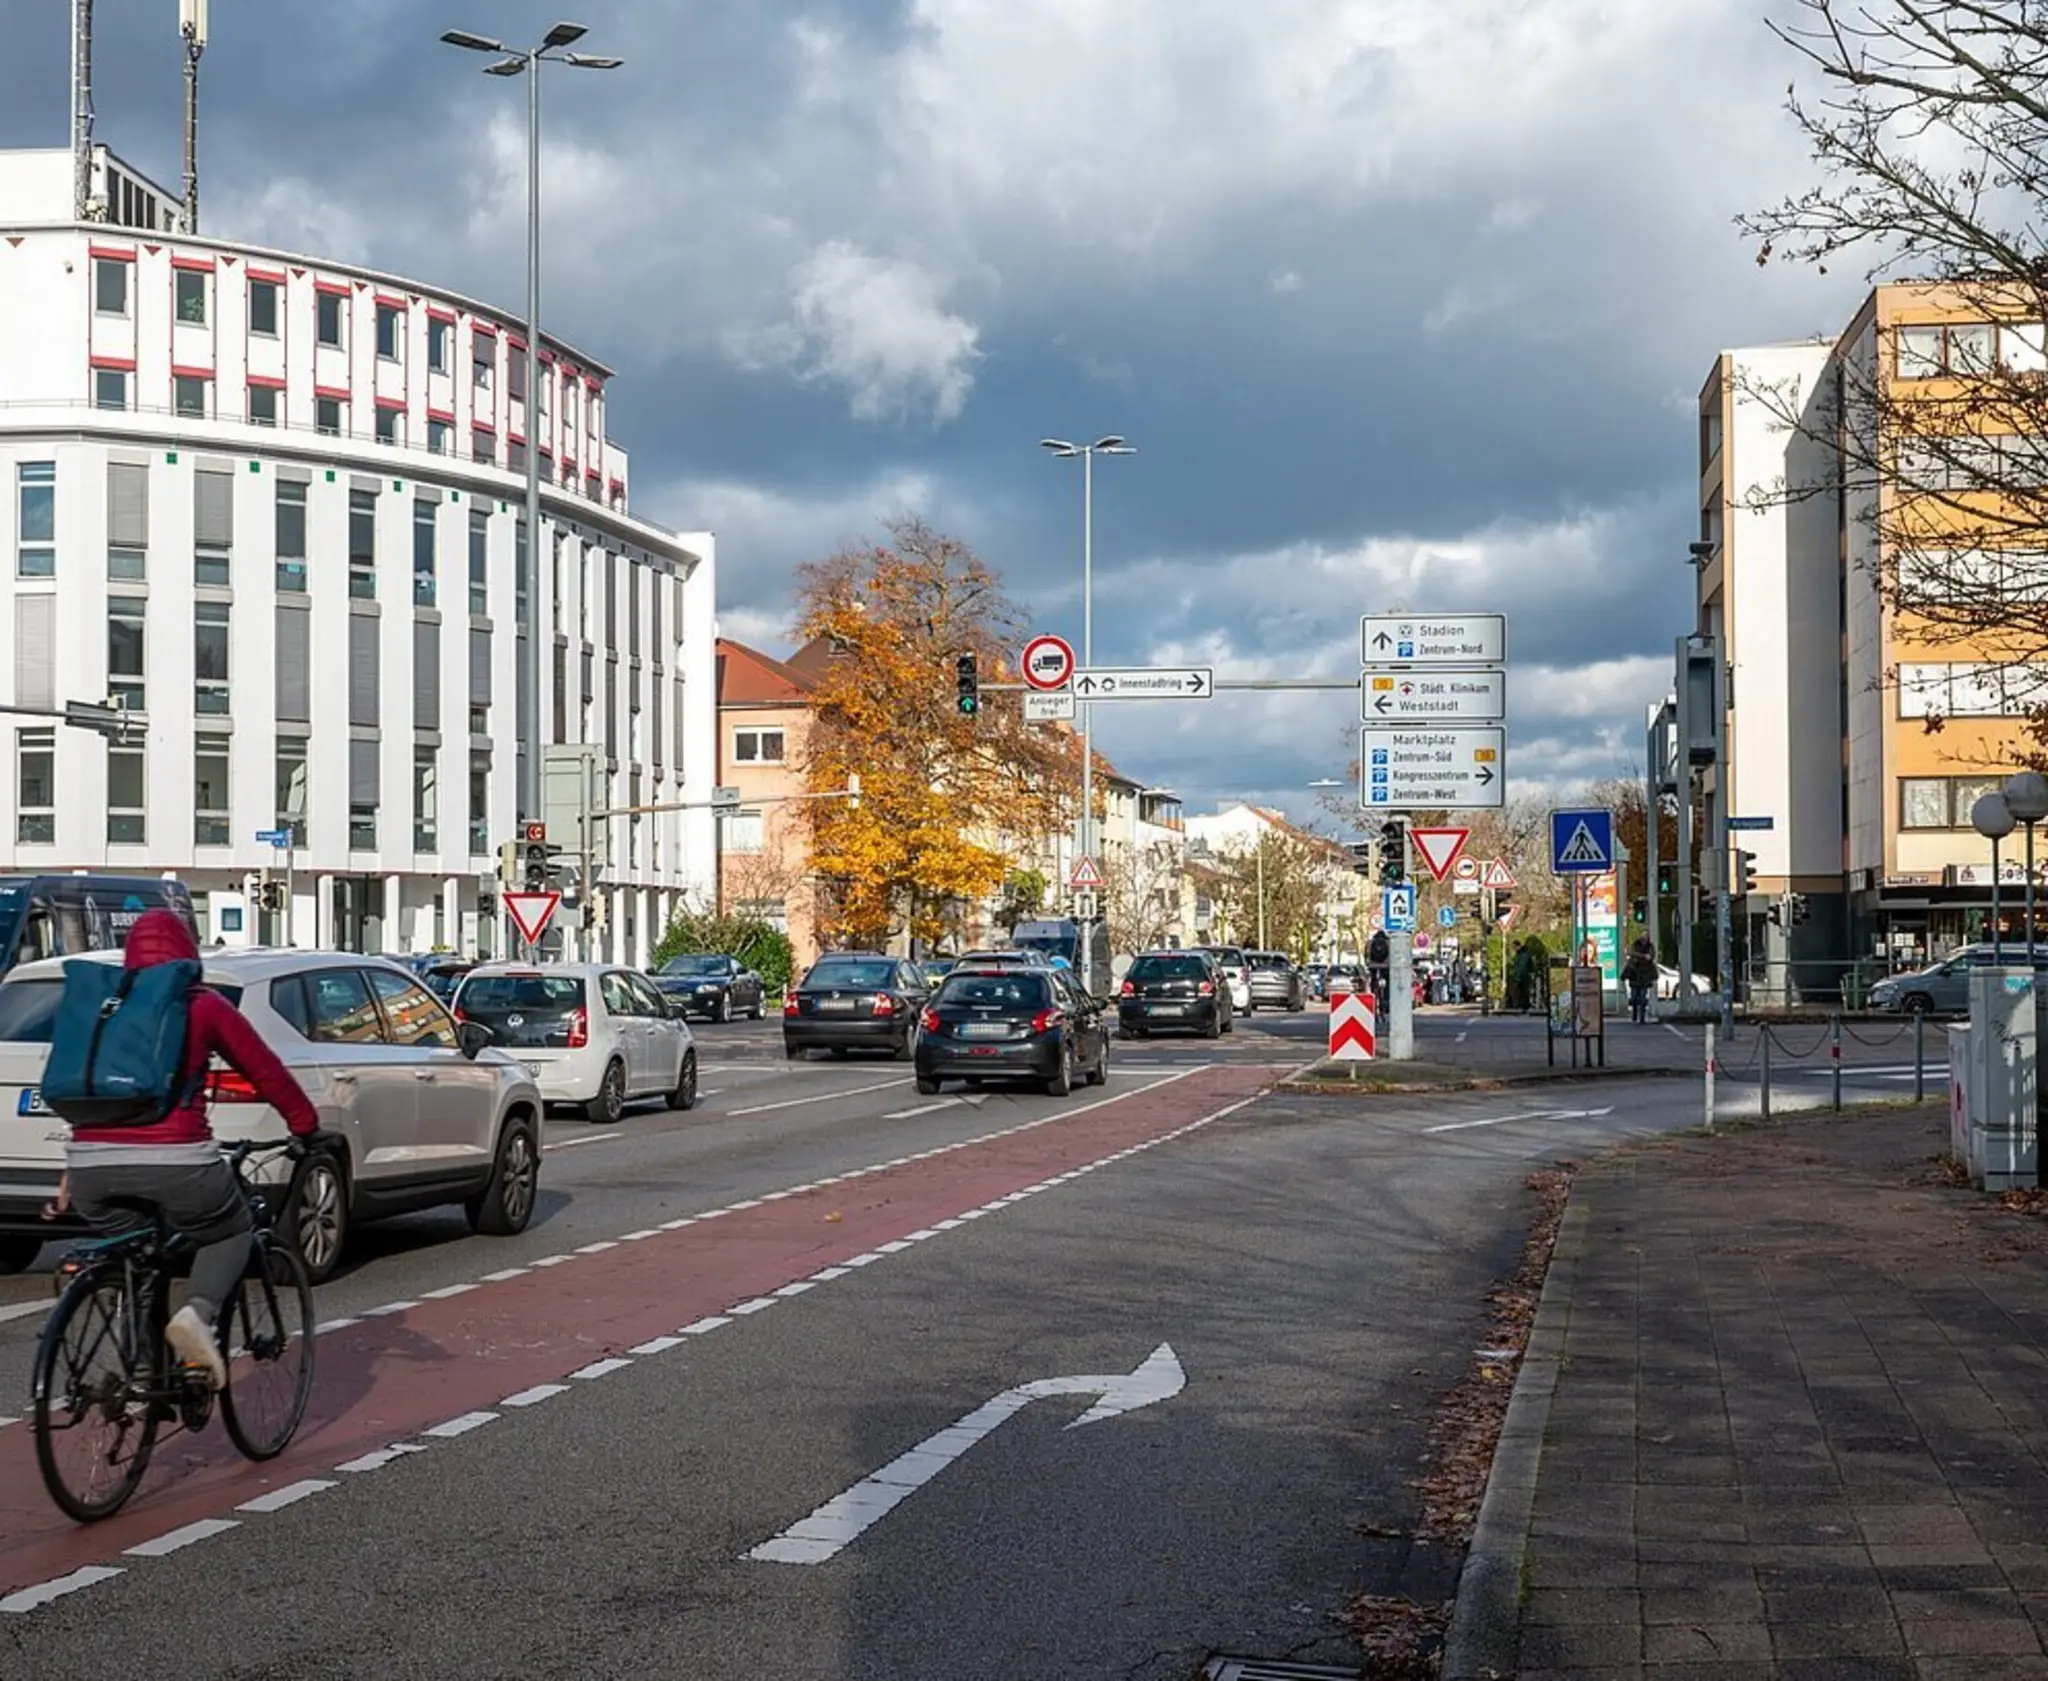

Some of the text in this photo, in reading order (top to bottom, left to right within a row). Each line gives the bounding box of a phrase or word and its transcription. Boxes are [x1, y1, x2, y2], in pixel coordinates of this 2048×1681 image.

[1419, 625, 1465, 637] Stadion
[1419, 643, 1484, 656] Zentrum-Nord
[1119, 677, 1183, 691] Innenstadtring
[1450, 683, 1490, 694] Klinikum
[1400, 701, 1459, 712] Weststadt
[1393, 734, 1457, 748] Marktplatz
[1393, 750, 1453, 763] Zentrum-Süd
[1393, 771, 1470, 782] Kongresszentrum
[1393, 788, 1457, 800] Zentrum-West
